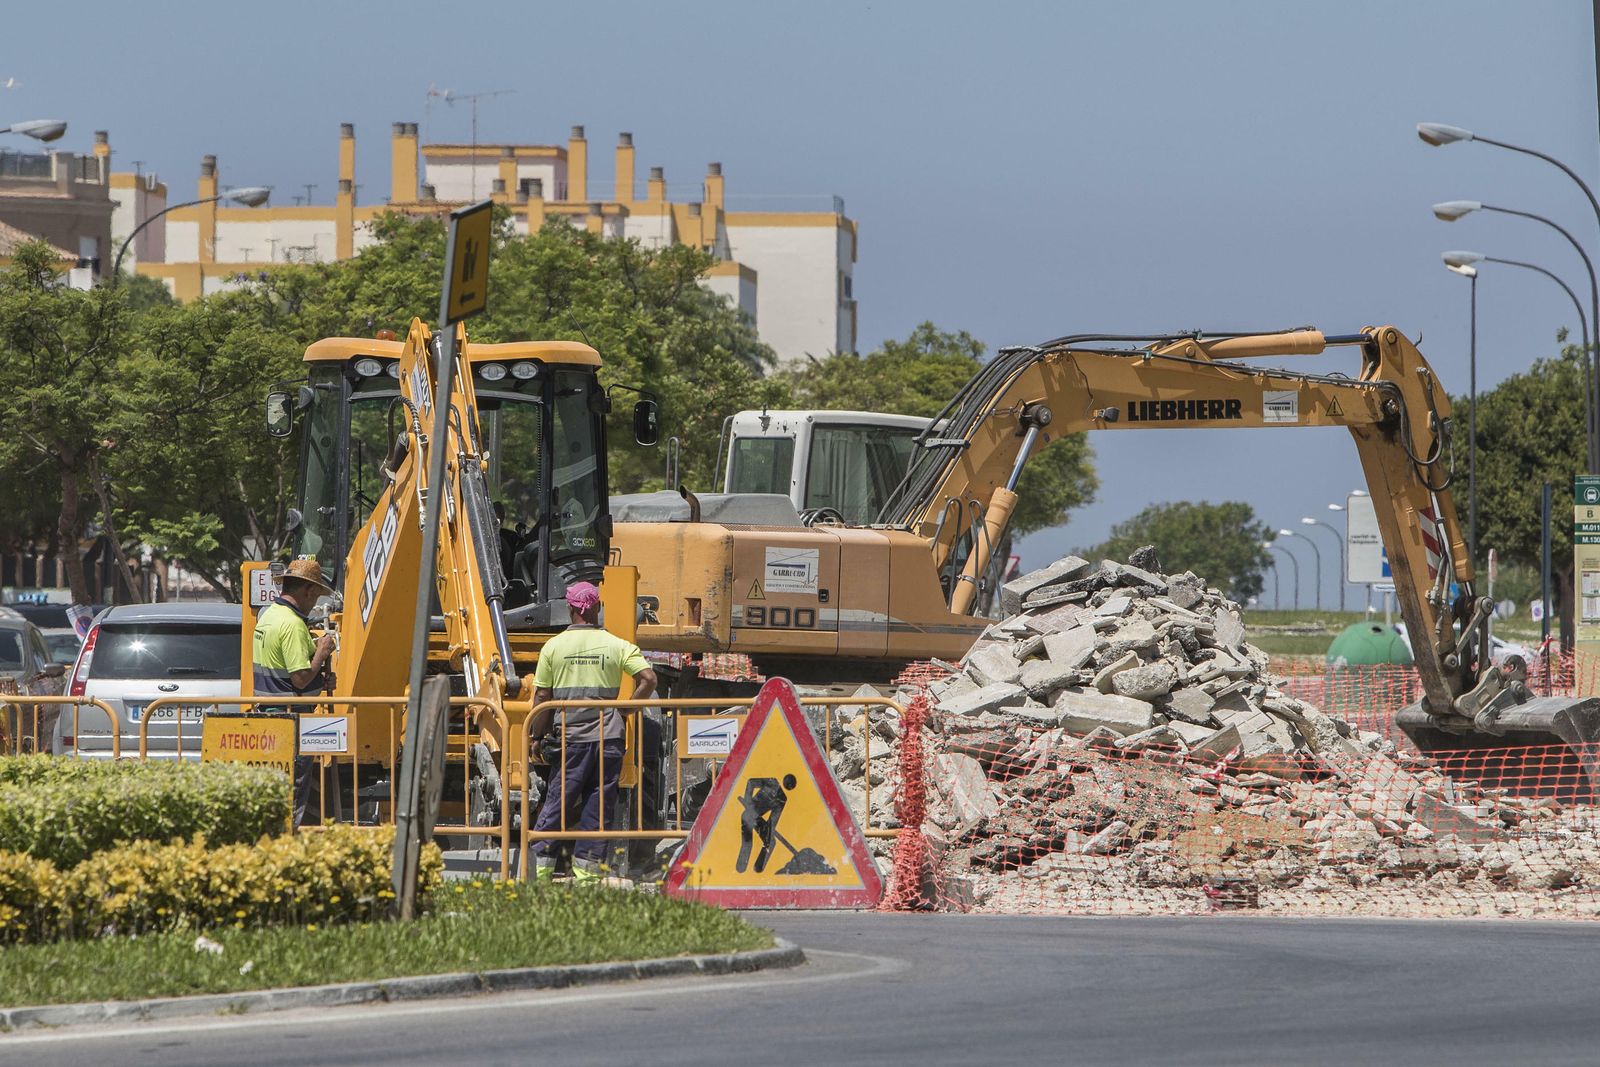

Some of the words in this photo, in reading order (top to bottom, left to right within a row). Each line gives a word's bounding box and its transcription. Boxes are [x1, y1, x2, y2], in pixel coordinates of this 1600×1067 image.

[1128, 399, 1242, 422] LIEBHERR
[1586, 509, 1594, 518] B
[361, 503, 399, 624] JCB
[258, 573, 266, 586] E
[747, 606, 816, 628] 900
[219, 731, 276, 750] ATENCIÓN
